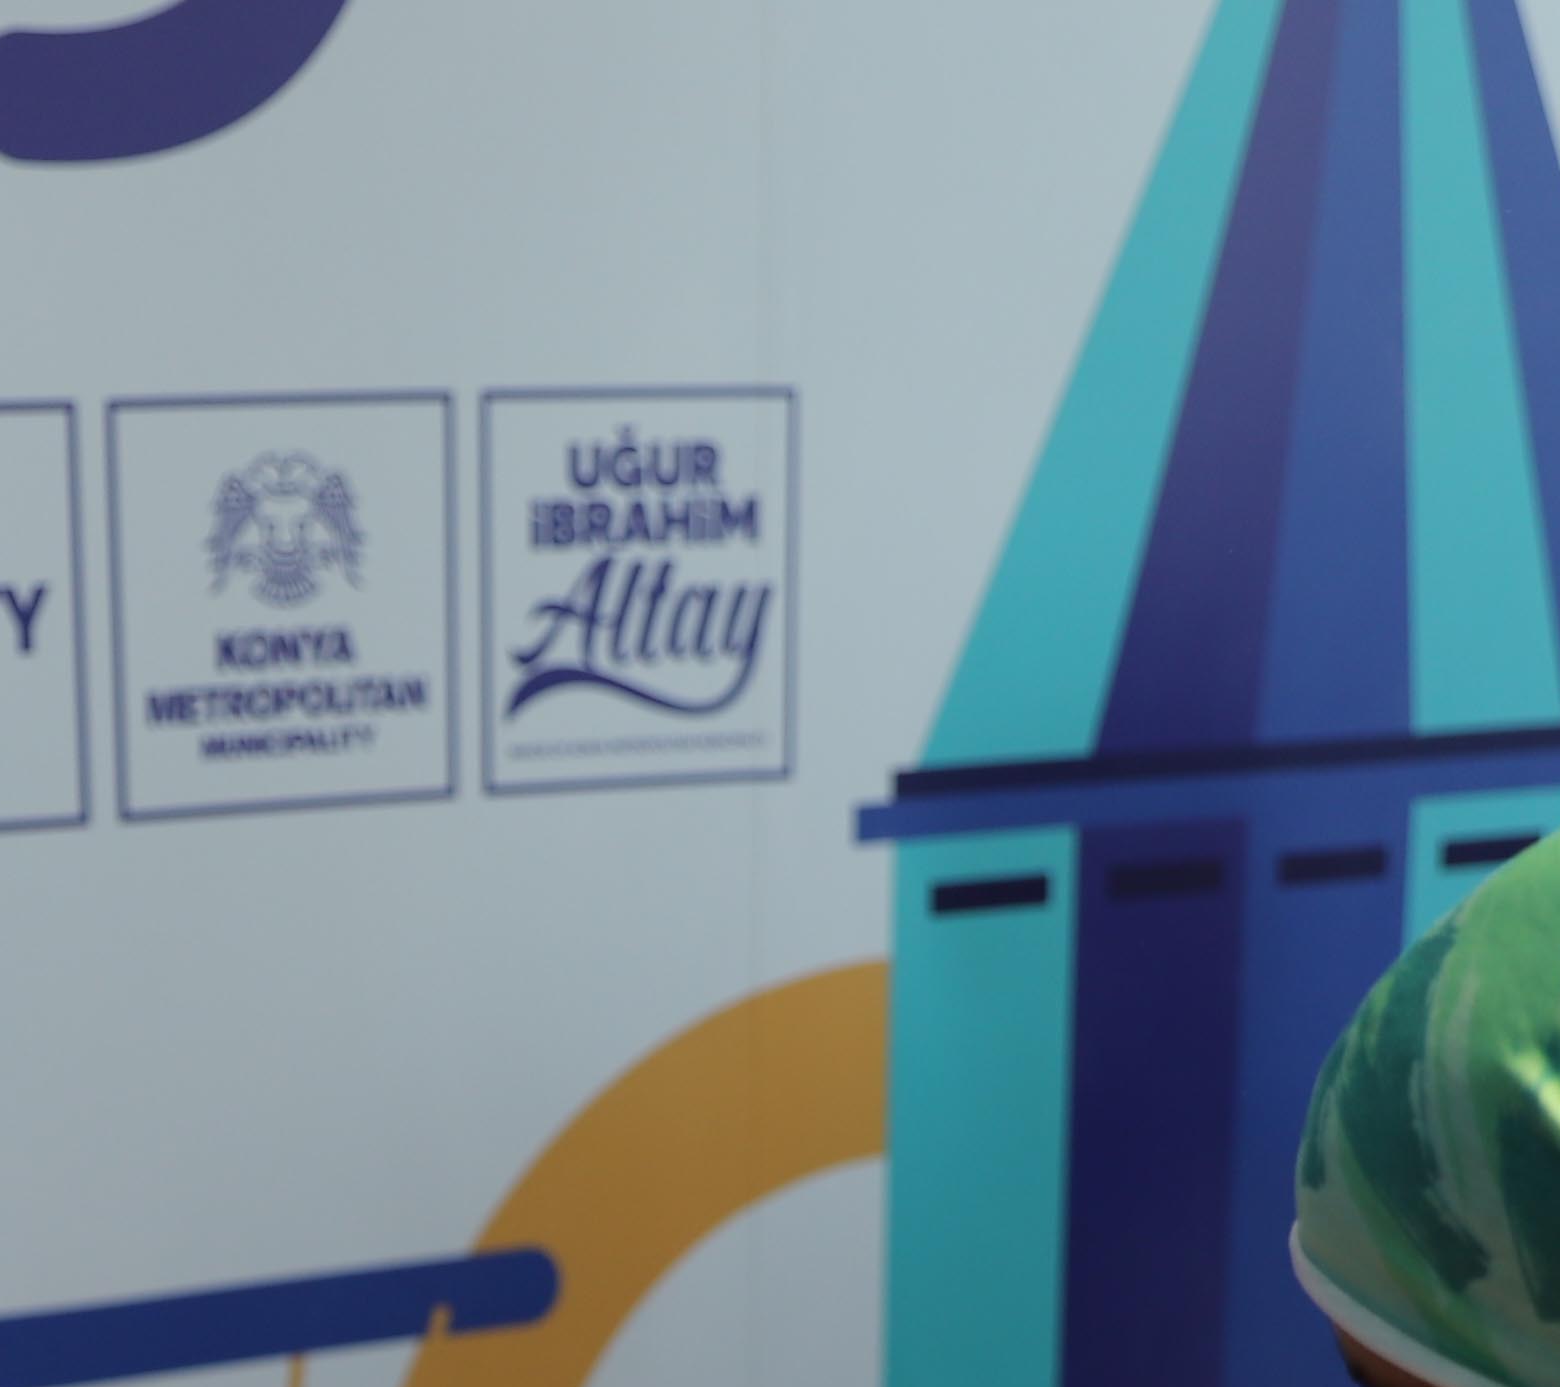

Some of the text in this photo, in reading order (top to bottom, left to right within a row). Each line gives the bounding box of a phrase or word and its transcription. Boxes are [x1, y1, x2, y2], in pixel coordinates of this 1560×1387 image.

[566, 424, 722, 490] UĞUR
[215, 626, 356, 670] KONYA
[504, 558, 772, 722] Altay
[145, 674, 429, 727] METROPOLITAN
